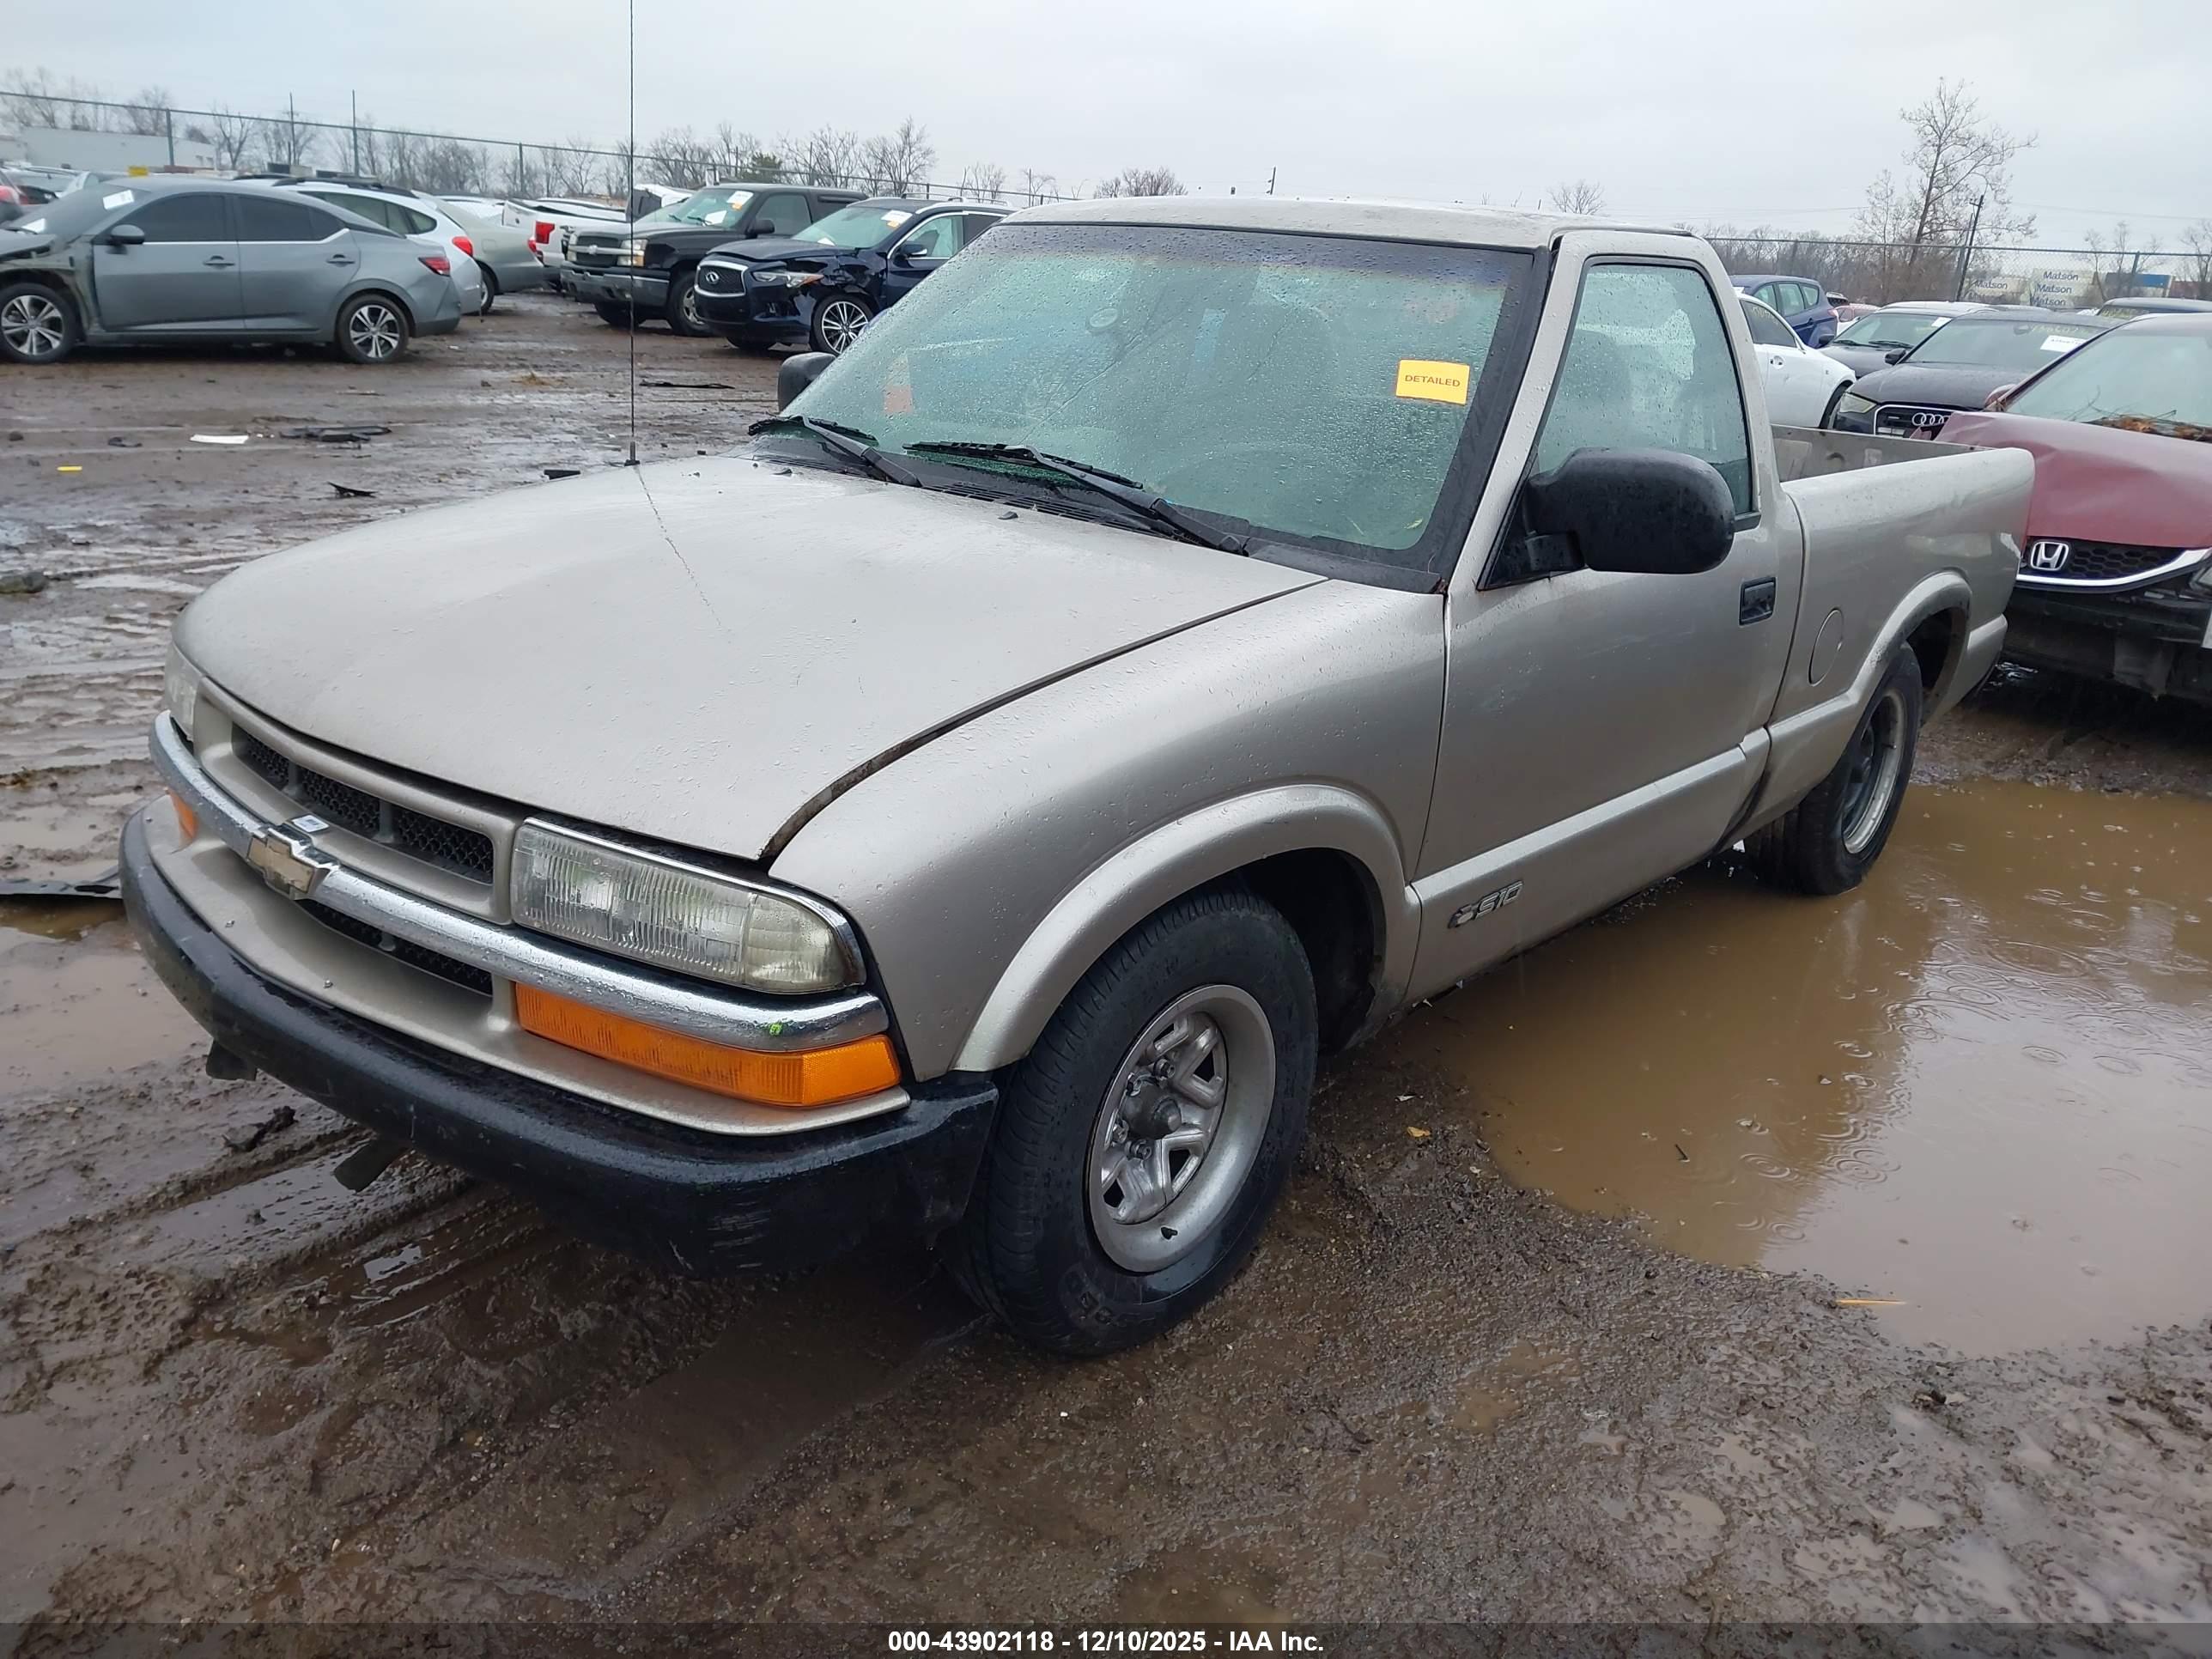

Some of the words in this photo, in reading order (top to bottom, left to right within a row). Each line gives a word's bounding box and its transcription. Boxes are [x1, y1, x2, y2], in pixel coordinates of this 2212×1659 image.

[2044, 270, 2079, 281] Matson
[1975, 280, 2008, 289] Matson
[2036, 283, 2072, 294] Matson
[1405, 374, 1461, 387] DETAILED
